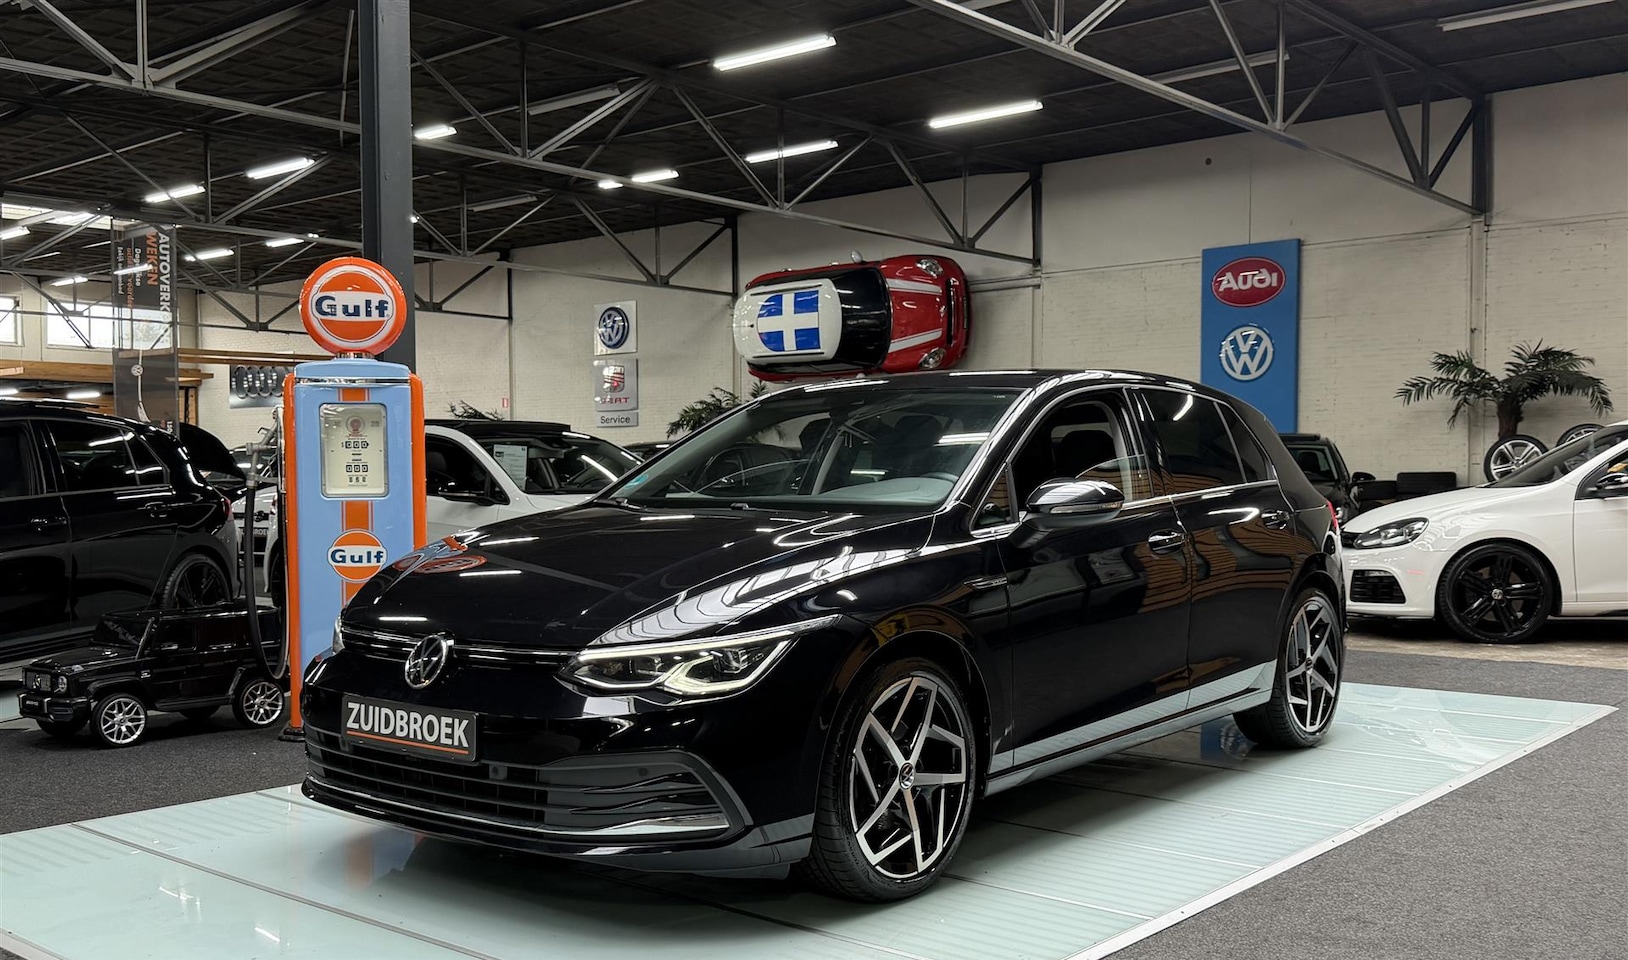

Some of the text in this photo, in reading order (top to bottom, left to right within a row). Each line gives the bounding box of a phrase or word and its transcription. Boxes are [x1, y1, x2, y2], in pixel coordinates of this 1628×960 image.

[146, 231, 159, 286] WEKEN
[1218, 268, 1279, 292] Audi
[315, 295, 389, 318] Gulf
[600, 415, 631, 425] Service
[330, 548, 384, 564] Gulf
[346, 701, 470, 748] ZUIDBROEK
